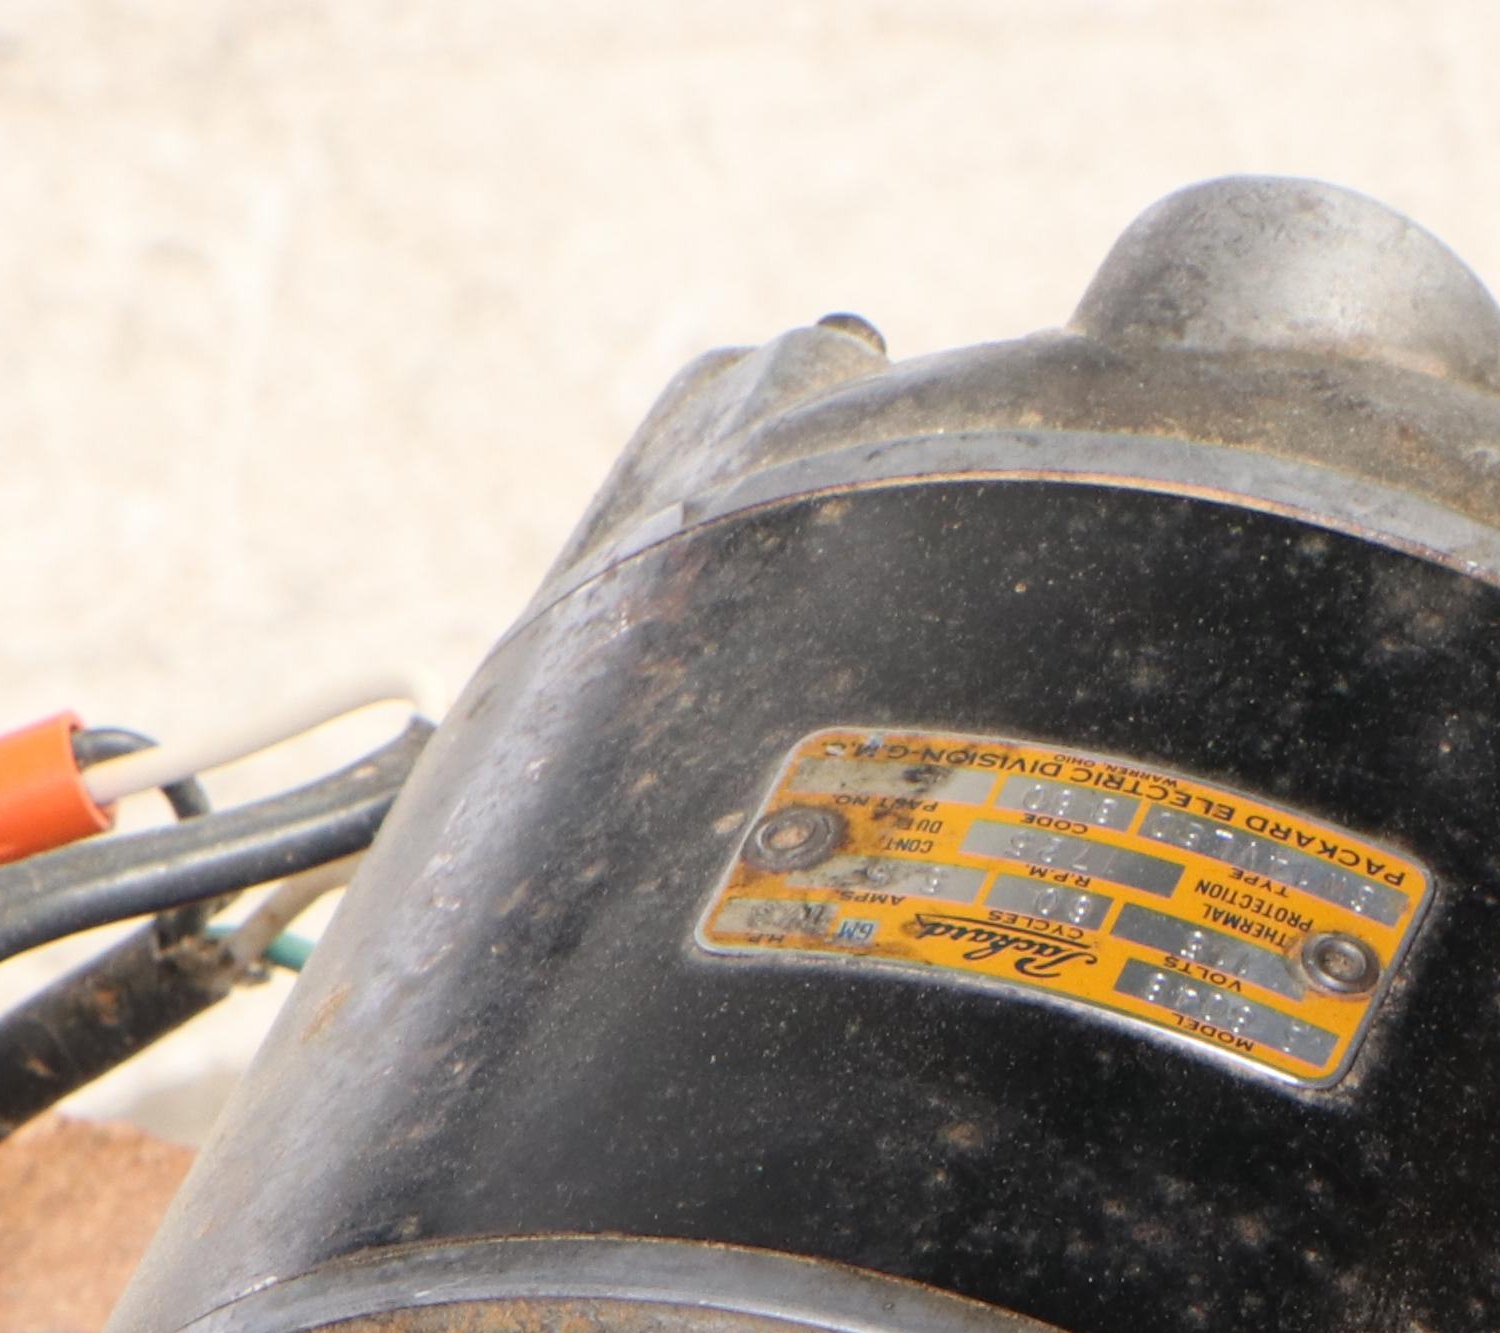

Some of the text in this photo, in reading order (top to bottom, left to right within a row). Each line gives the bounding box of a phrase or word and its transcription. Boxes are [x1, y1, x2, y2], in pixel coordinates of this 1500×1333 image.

[1052, 753, 1095, 767] OHIO
[832, 793, 870, 806] NO.
[1071, 768, 1237, 822] ELECTRIC
[1020, 812, 1089, 835] CODE
[1245, 815, 1406, 887] PACKARD
[1025, 864, 1092, 887] R.P.M.
[1227, 866, 1289, 899] TYPE
[1194, 878, 1314, 934] PROTECTION
[744, 932, 786, 945] H.P.
[836, 920, 876, 941] GM
[987, 909, 1084, 940] CYCLES
[1202, 902, 1287, 949] THERMAL
[914, 913, 1097, 980] Packard
[1163, 955, 1242, 994] VOLTS
[1171, 1012, 1254, 1052] MODEL
